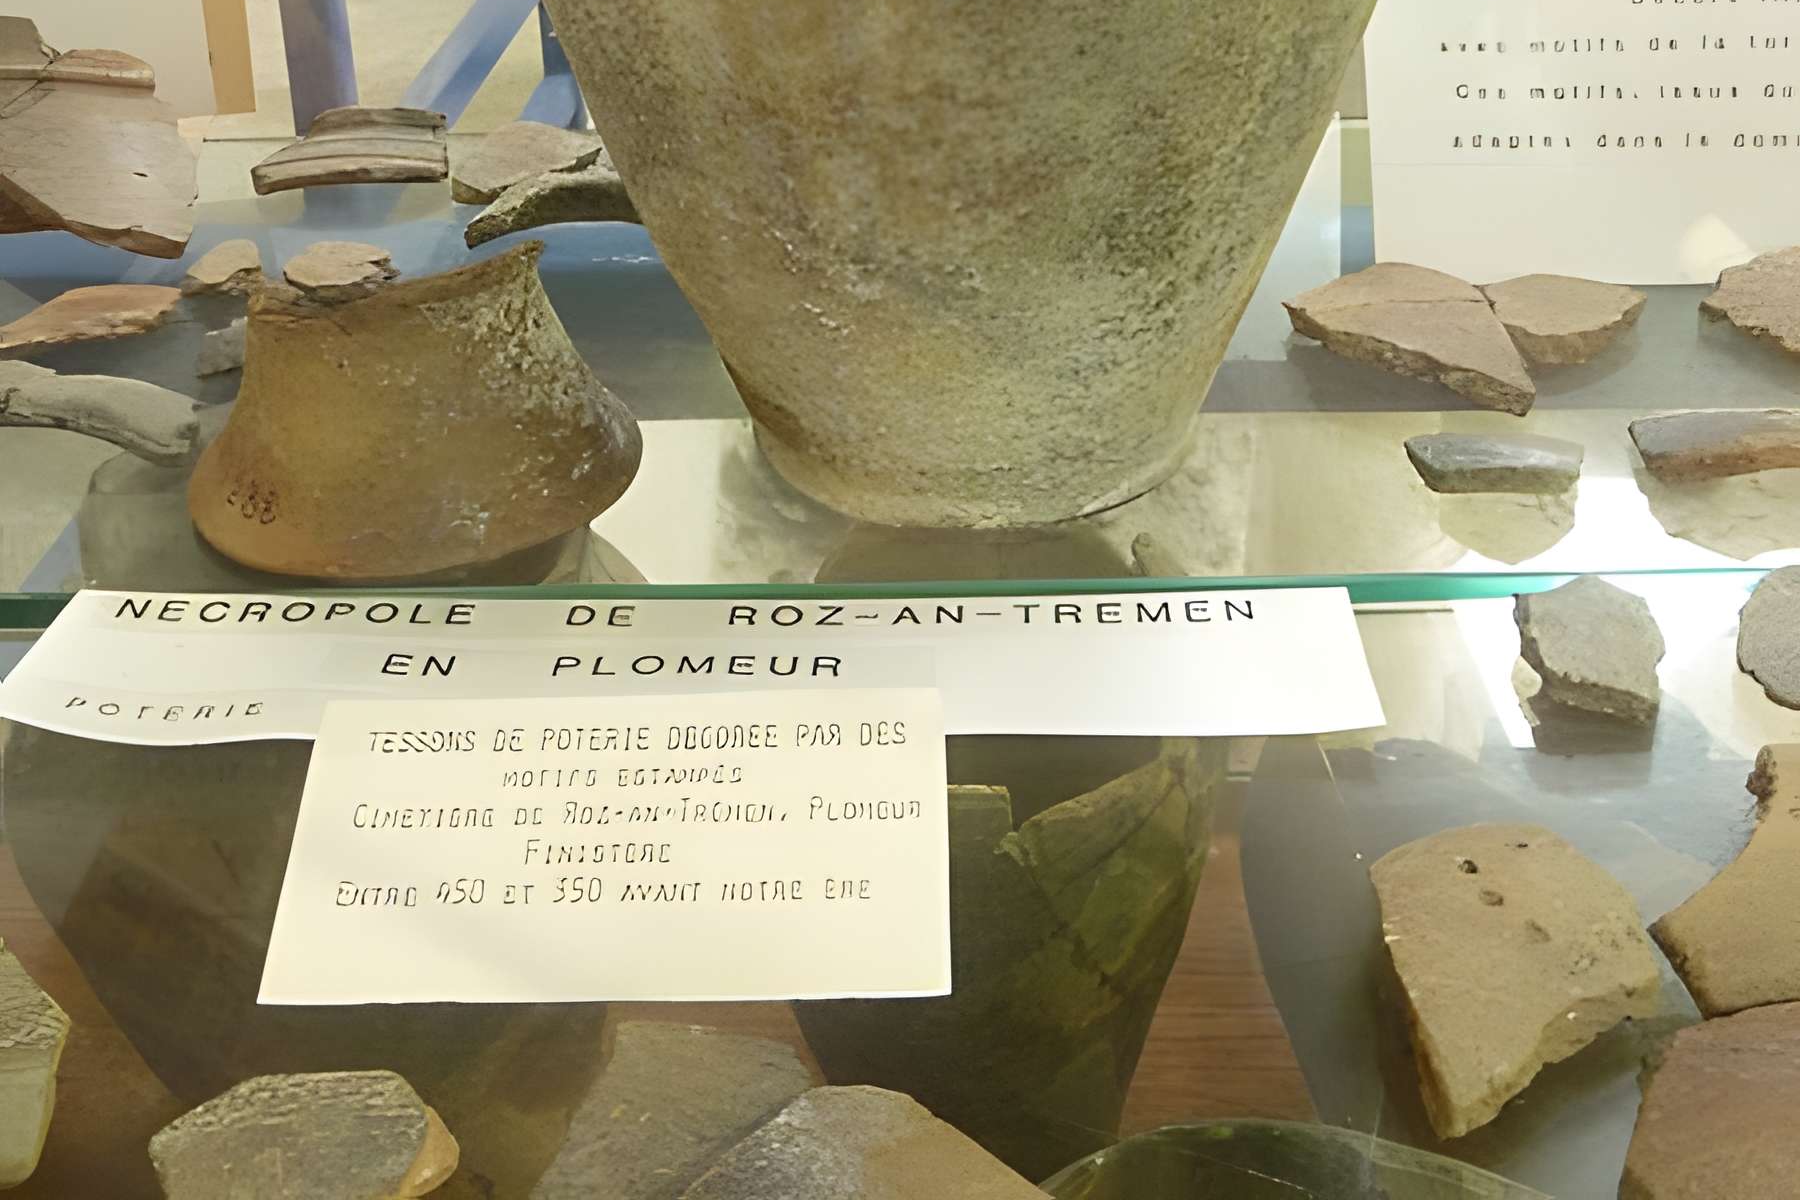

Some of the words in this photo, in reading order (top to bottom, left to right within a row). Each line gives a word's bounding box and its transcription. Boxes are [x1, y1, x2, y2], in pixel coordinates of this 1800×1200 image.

[114, 598, 476, 626] NECROPOLE
[565, 605, 636, 628] DE
[380, 652, 457, 677] EN
[551, 655, 842, 678] PLOMEUR
